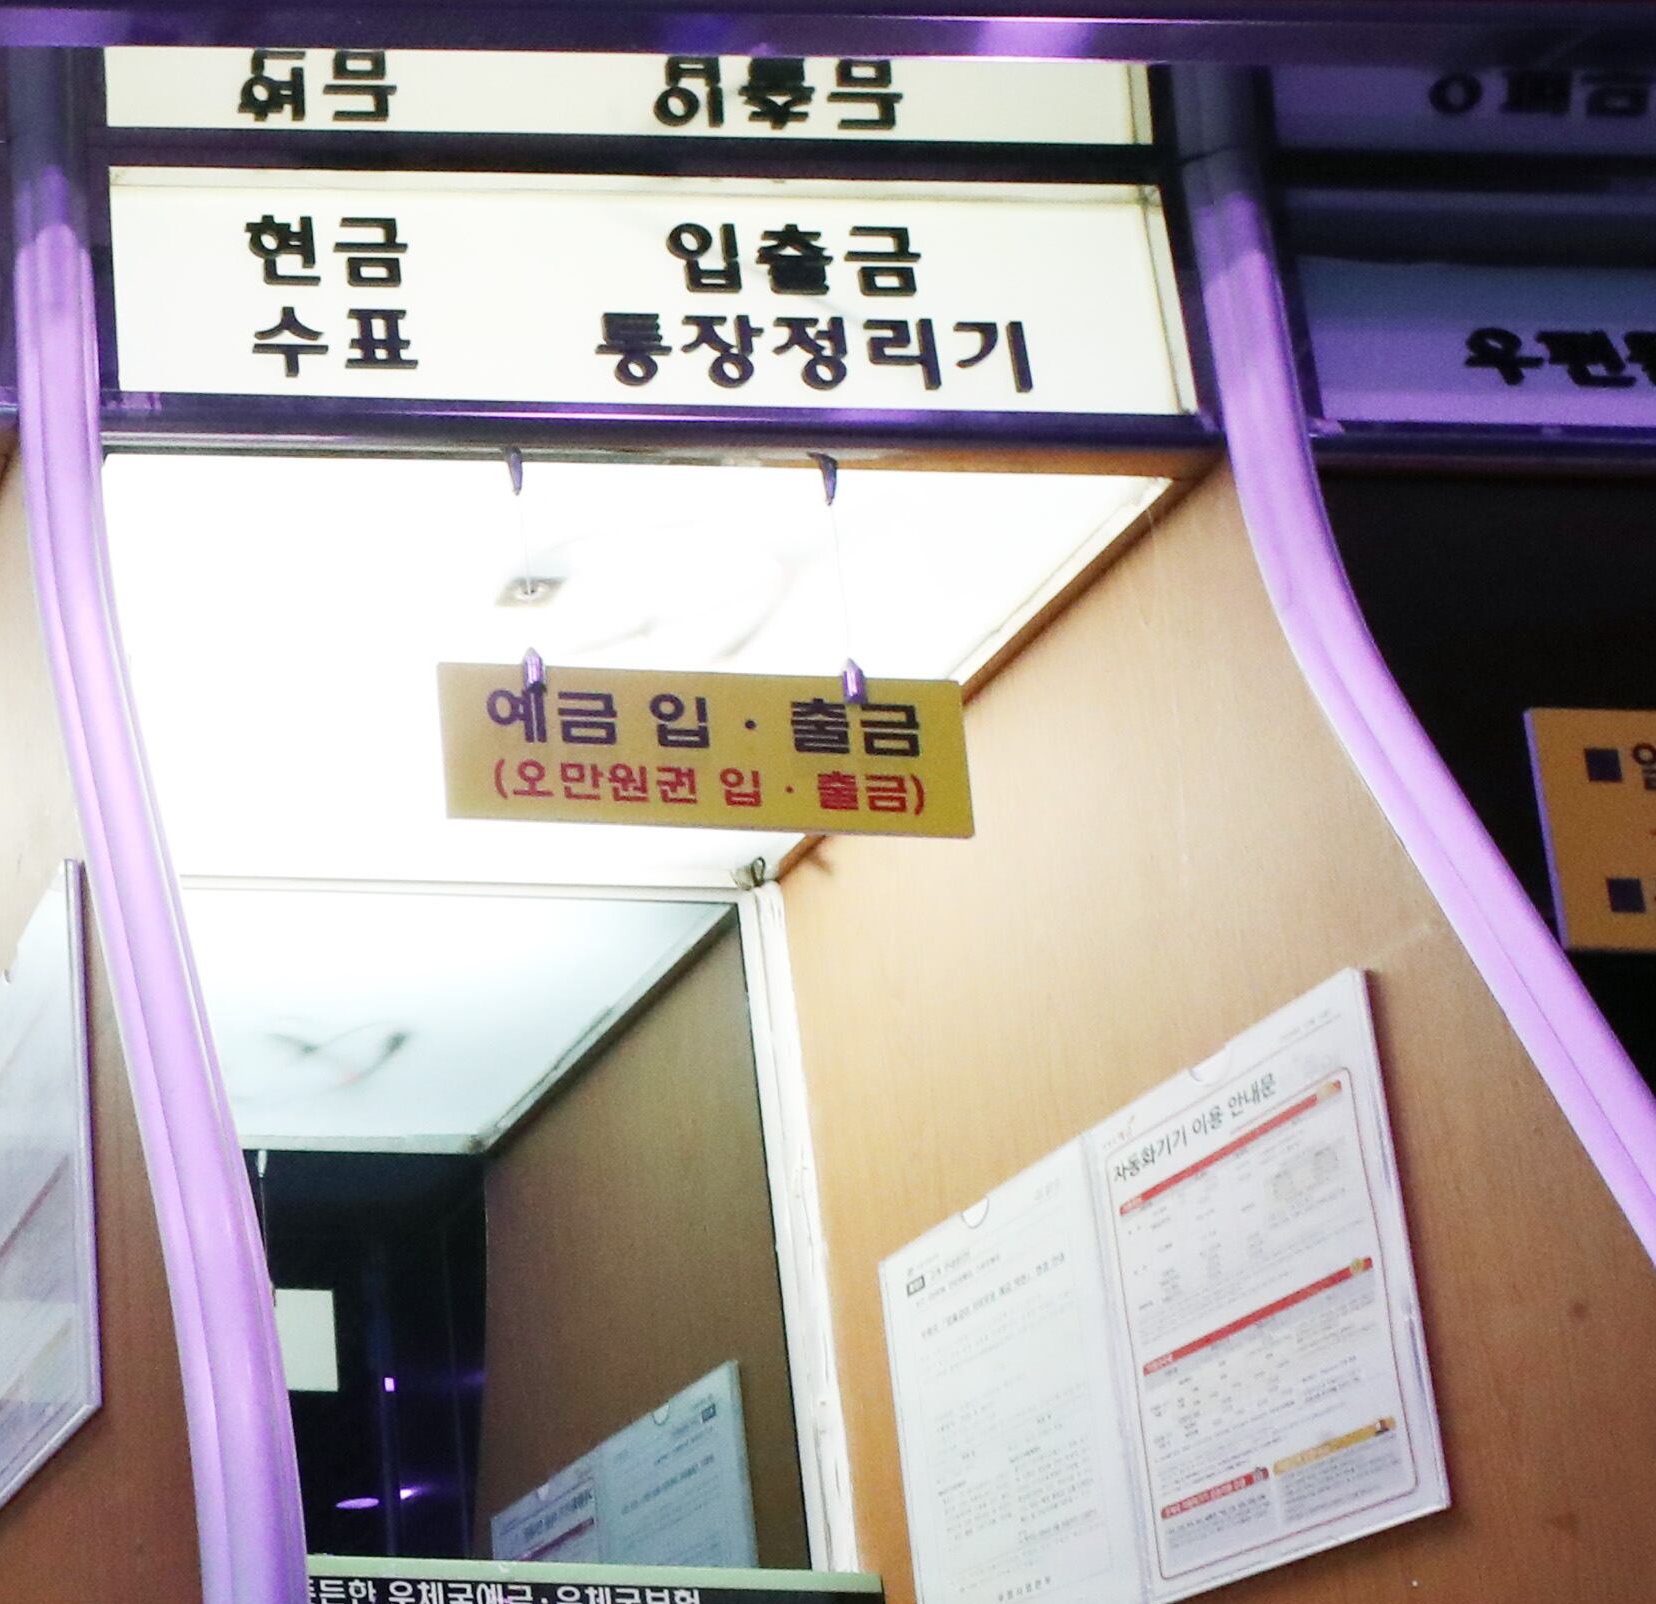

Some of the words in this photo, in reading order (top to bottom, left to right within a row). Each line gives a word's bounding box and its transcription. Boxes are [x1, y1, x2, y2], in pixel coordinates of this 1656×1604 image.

[243, 216, 410, 287] 현금
[665, 223, 922, 296] 입출금
[253, 306, 419, 378] 수표
[596, 311, 1033, 394] 통장정리기
[487, 688, 617, 745] 예금
[494, 759, 697, 804] (오만원권
[1192, 1106, 1222, 1135] 이용
[1228, 1073, 1276, 1117] 안내문
